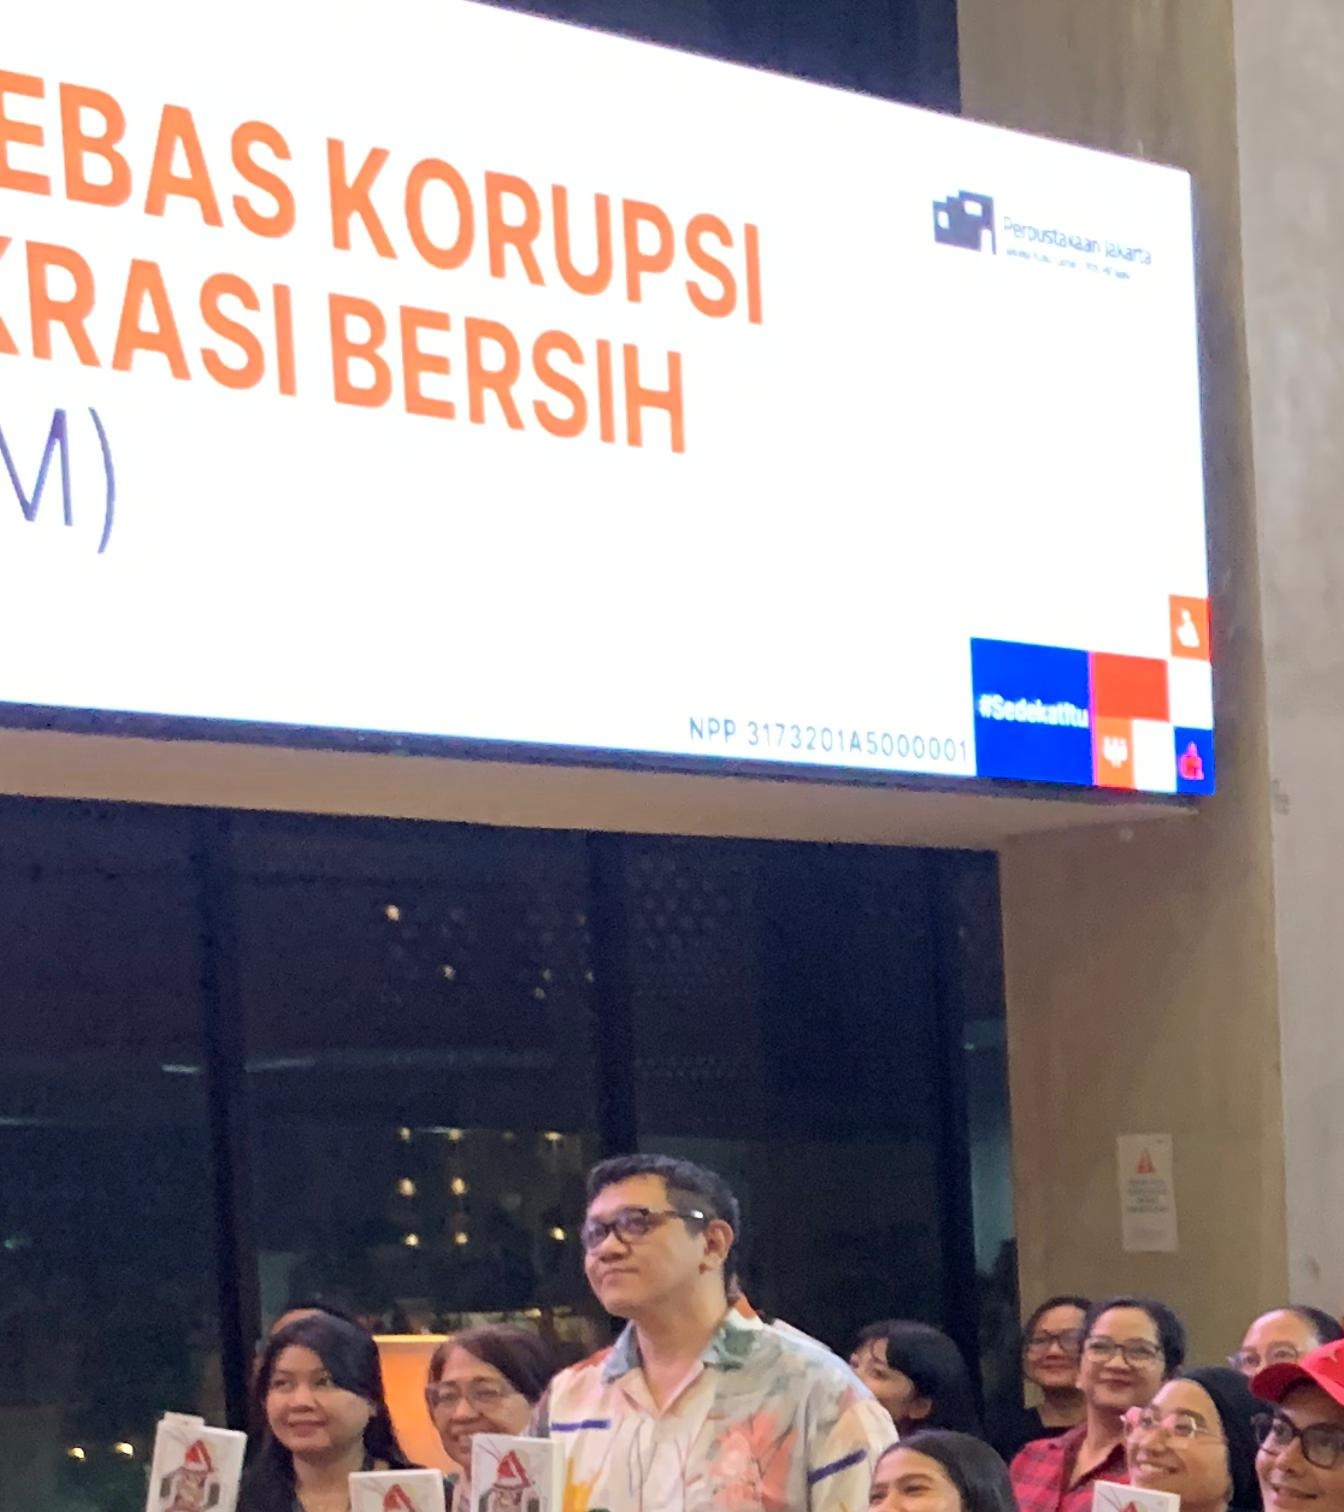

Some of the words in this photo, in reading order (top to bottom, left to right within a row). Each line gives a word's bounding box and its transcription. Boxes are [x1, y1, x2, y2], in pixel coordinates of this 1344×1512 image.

[326, 136, 765, 327] KORUPSI
[329, 297, 687, 456] BERSIH
[689, 716, 737, 744] NPP
[746, 720, 968, 763] 3173201A5000001
